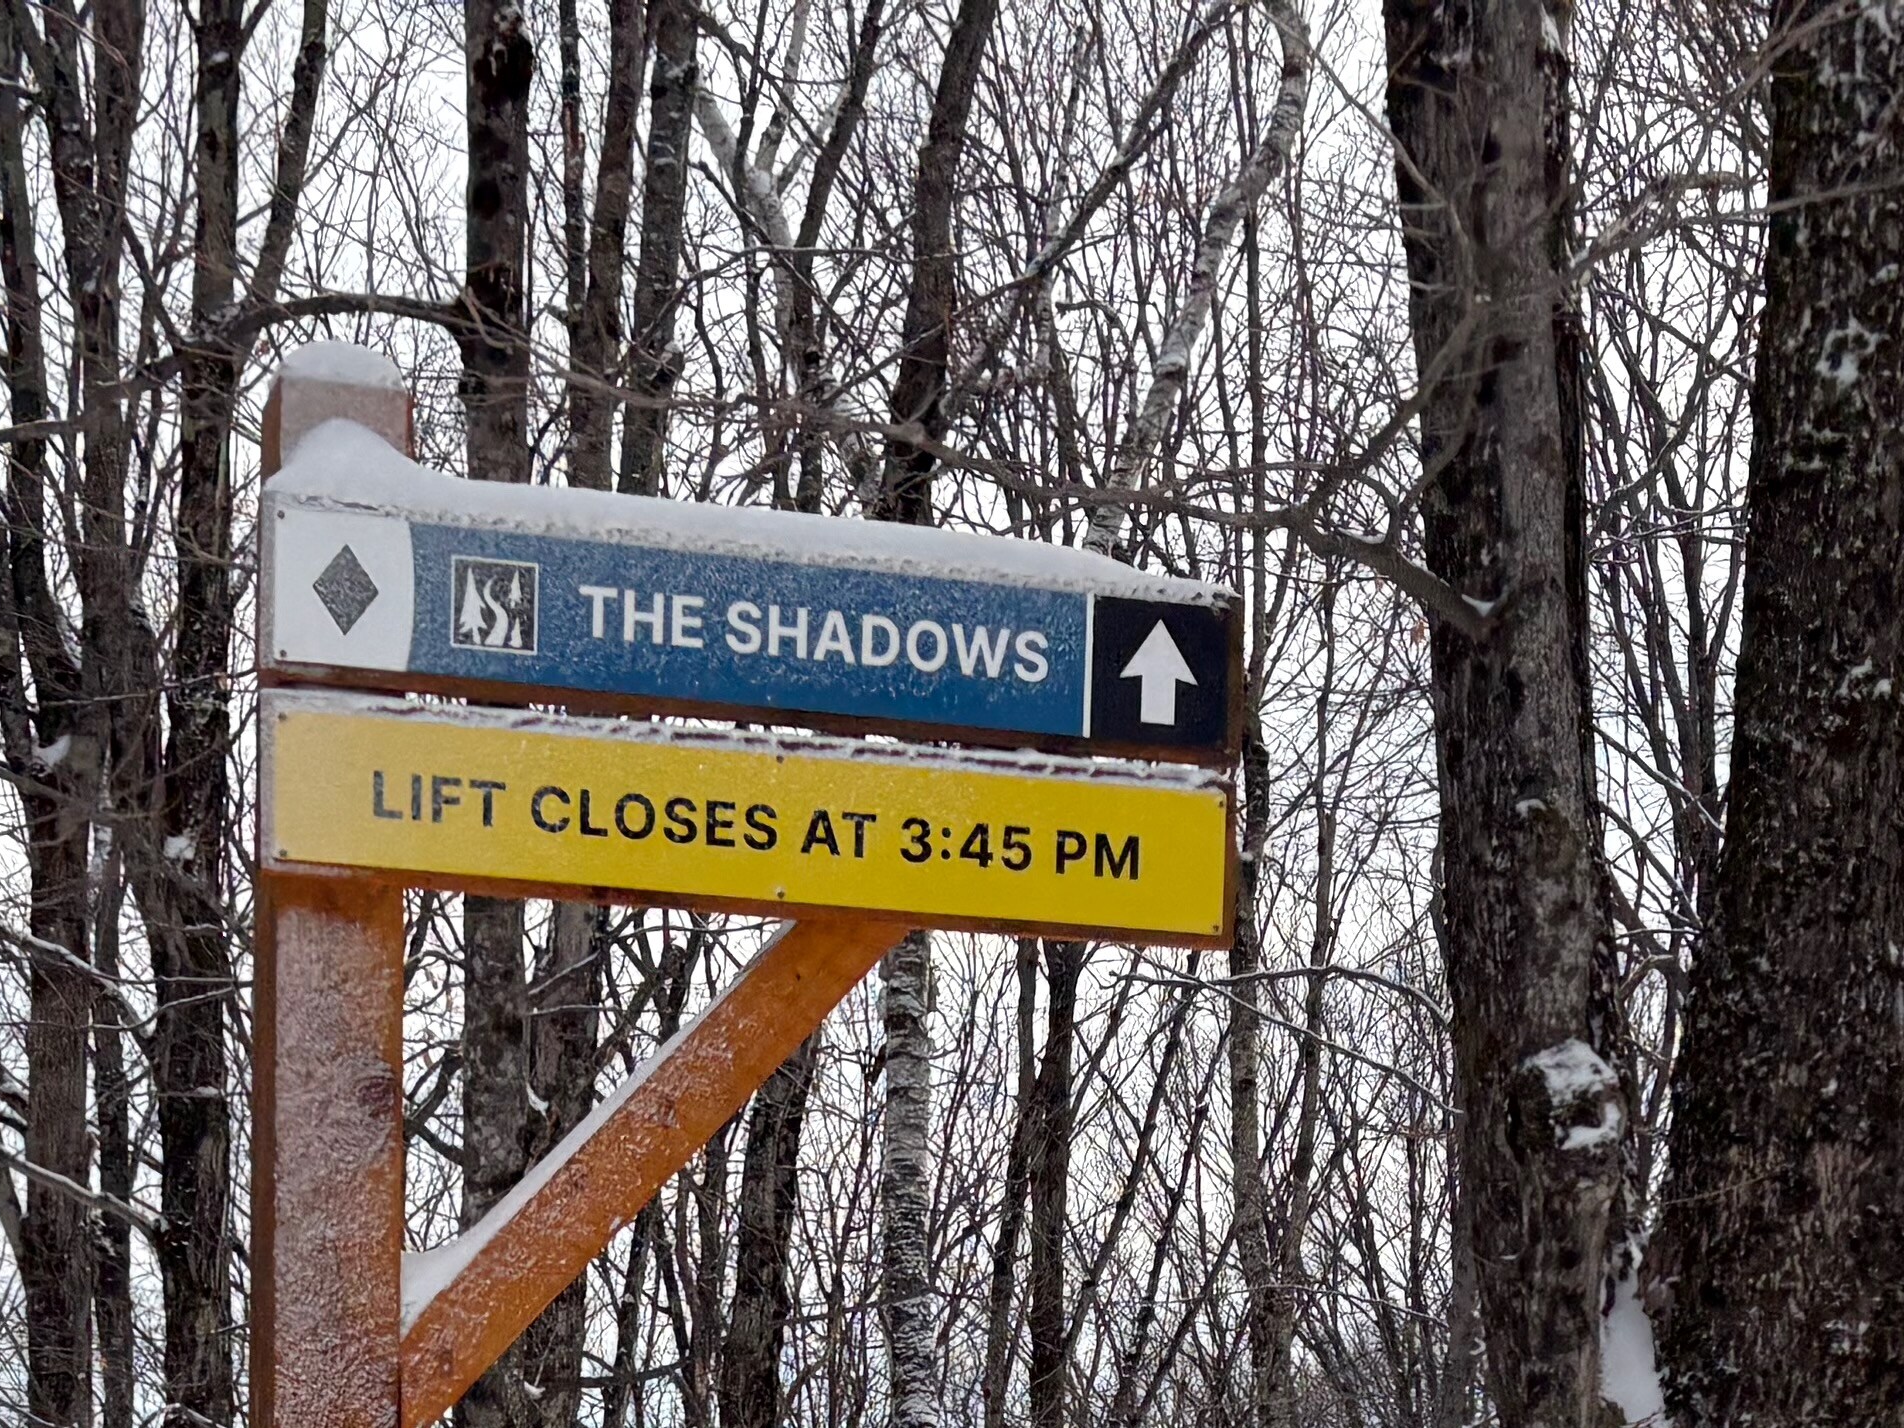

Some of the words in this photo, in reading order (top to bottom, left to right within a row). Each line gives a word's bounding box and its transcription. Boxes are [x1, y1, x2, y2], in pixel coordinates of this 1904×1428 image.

[578, 584, 705, 651] THE
[724, 601, 1051, 684] SHADOWS
[370, 768, 507, 830] LIFT
[529, 784, 779, 852] CLOSES
[799, 809, 877, 859] AT
[899, 821, 1033, 873] 3:45
[1055, 830, 1142, 883] PM
